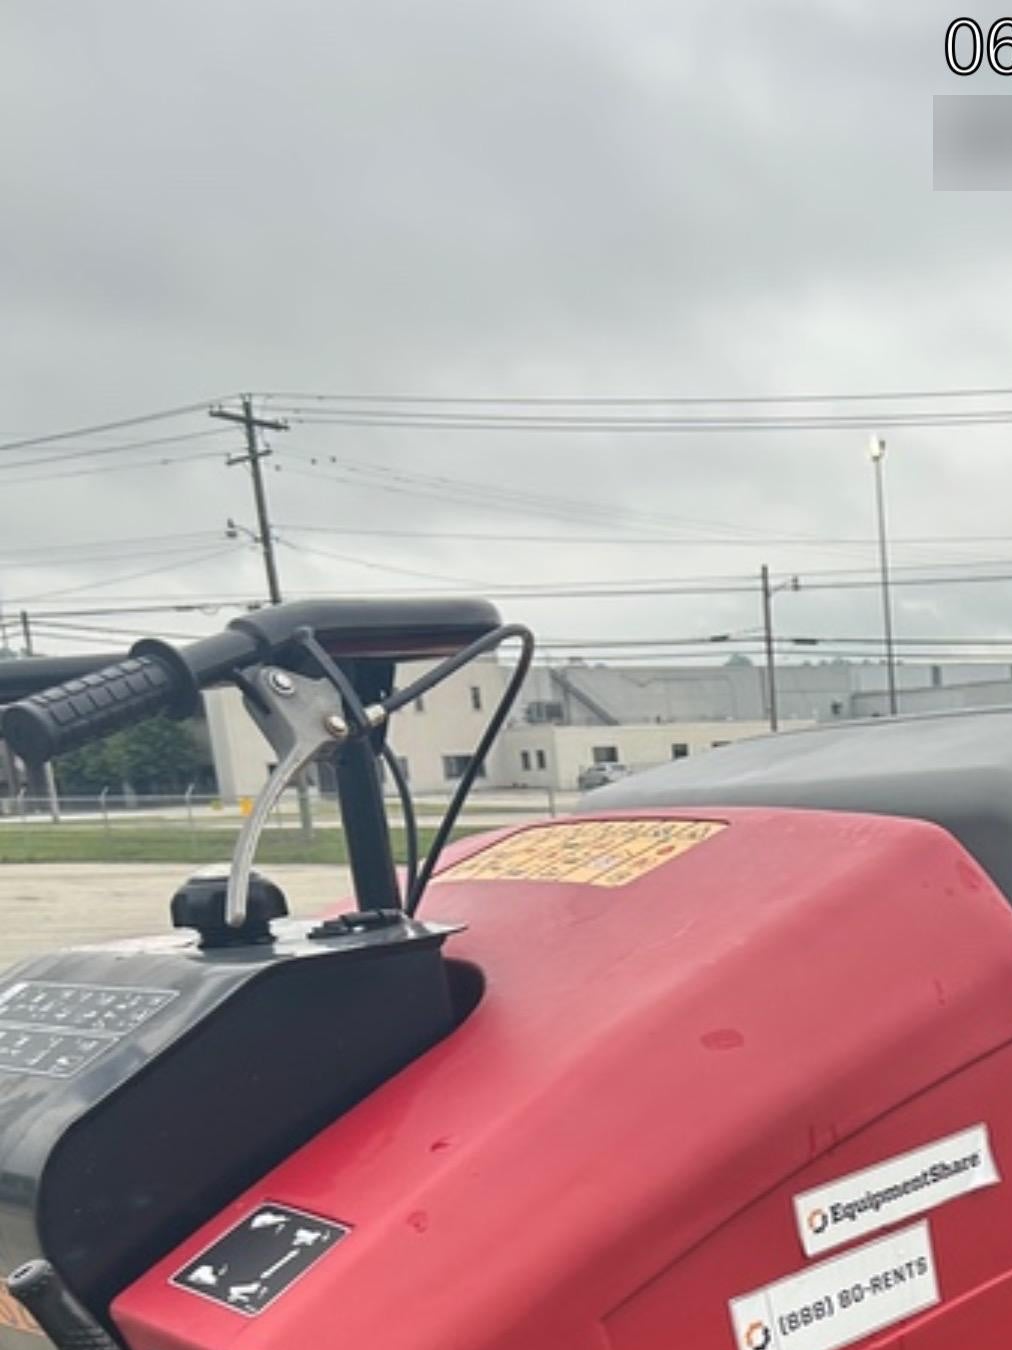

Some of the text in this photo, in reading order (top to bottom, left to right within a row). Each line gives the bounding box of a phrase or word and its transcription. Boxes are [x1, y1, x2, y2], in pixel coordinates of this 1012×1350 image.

[829, 1152, 982, 1225] EquipmentShare
[777, 1256, 929, 1336] (888) 80-RENTS
